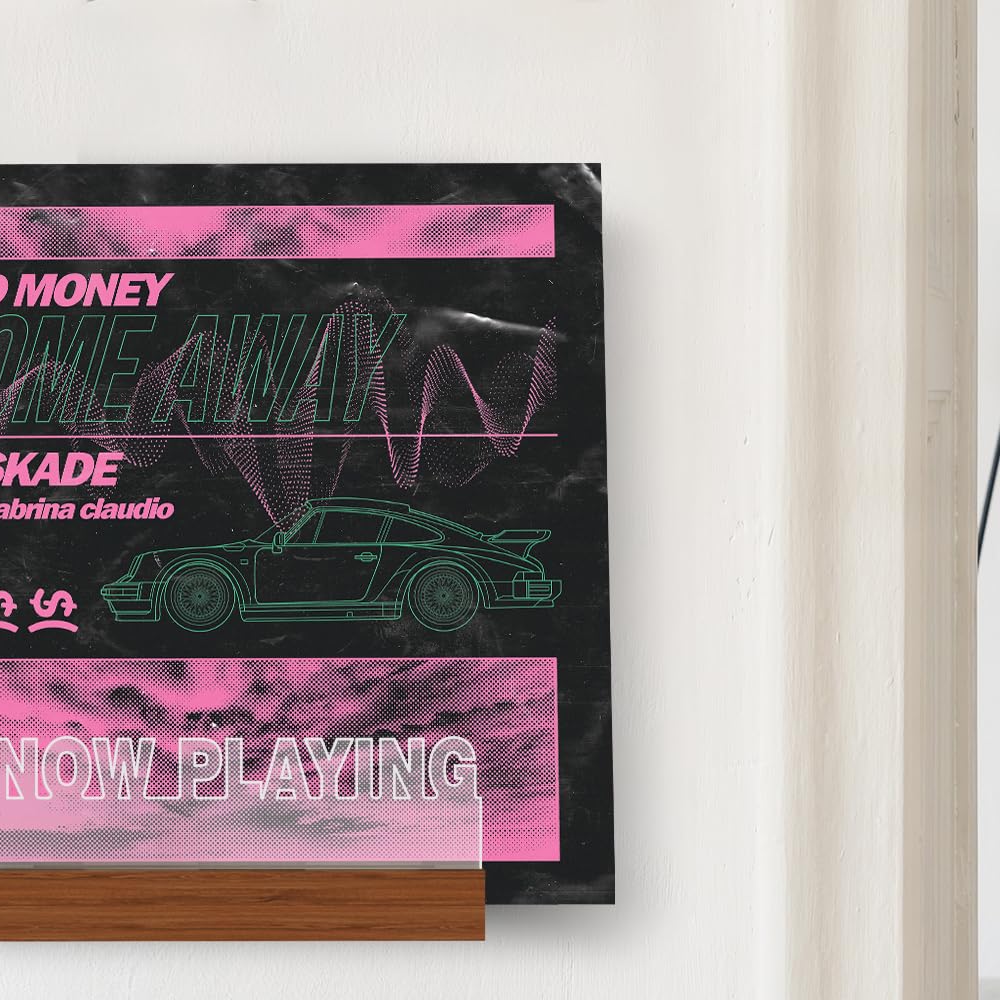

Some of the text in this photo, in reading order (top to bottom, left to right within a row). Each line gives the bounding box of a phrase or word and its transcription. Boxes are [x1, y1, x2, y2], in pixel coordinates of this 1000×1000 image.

[13, 272, 175, 307] MONEY
[151, 314, 407, 422] AWAY
[79, 497, 175, 520] claudio
[175, 735, 479, 800] PLAYING
